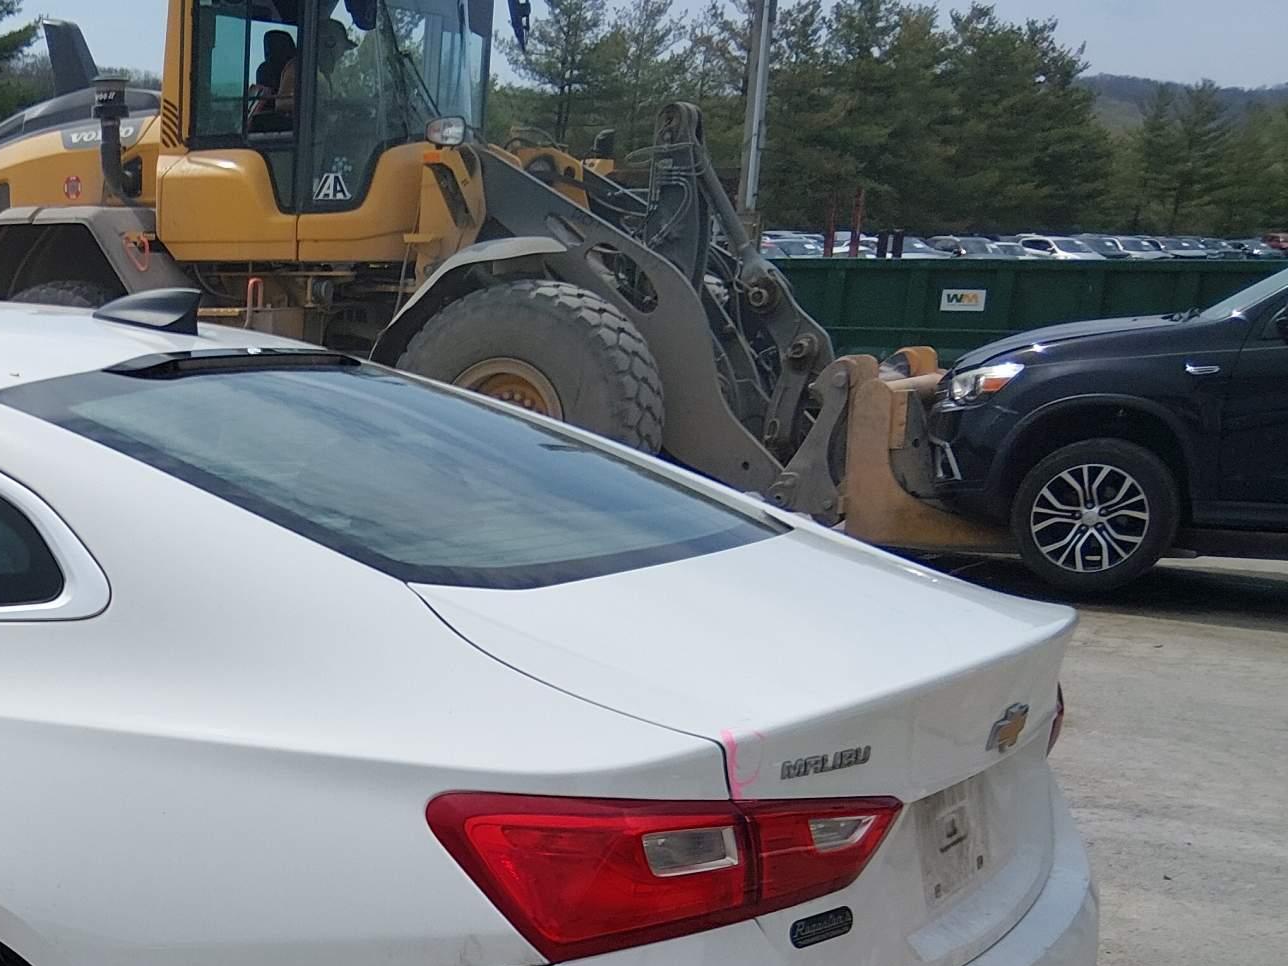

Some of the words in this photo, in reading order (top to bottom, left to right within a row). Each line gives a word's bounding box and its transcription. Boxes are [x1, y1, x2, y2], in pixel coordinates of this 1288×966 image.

[71, 126, 134, 143] VOO
[946, 293, 979, 304] WM
[780, 745, 872, 780] MALIBU
